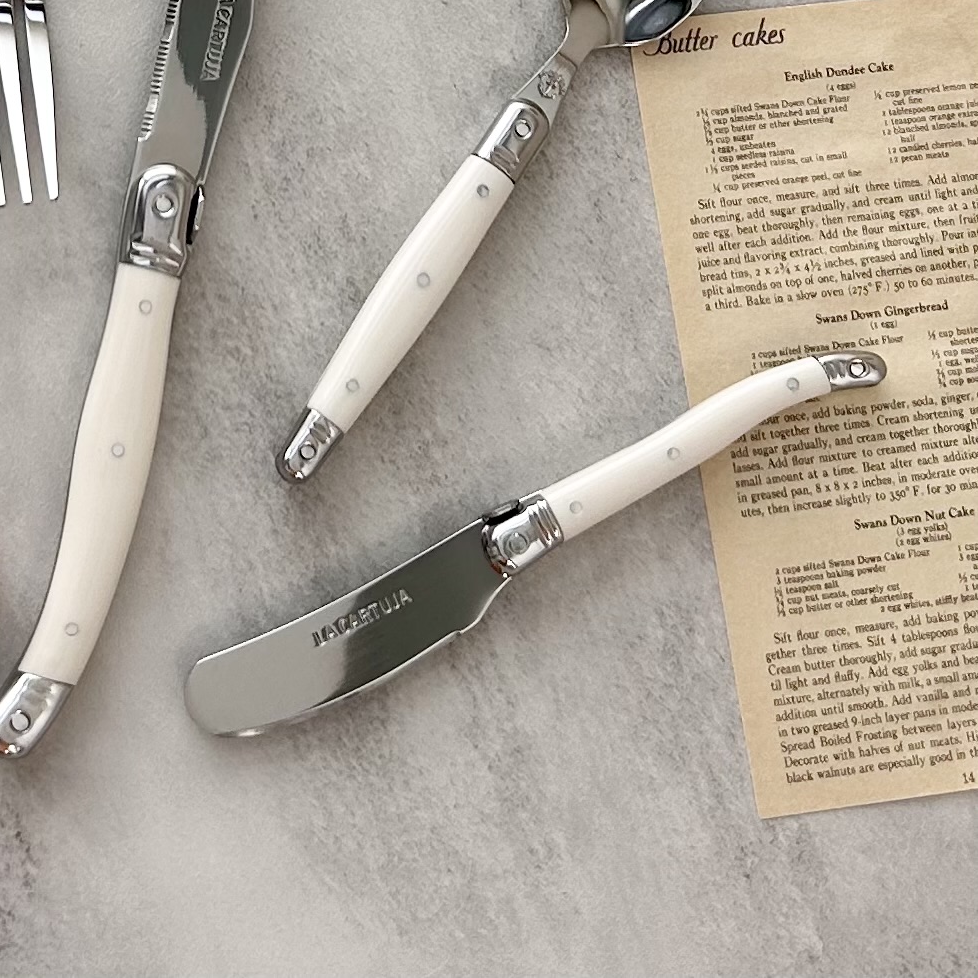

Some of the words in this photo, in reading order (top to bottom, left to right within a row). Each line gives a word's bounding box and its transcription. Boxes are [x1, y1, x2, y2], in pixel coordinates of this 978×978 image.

[643, 26, 718, 56] Butter
[732, 17, 786, 48] cakes
[784, 68, 822, 83] English
[826, 64, 865, 77] Dundee
[867, 60, 893, 73] Cake
[689, 211, 744, 225] shortening,
[746, 207, 765, 219] add
[769, 207, 796, 218] sugar
[800, 199, 849, 216] gradually,
[851, 196, 870, 207] and
[873, 195, 903, 205] cream
[908, 189, 931, 201] until
[934, 186, 958, 200] light
[960, 184, 978, 195] and
[697, 199, 716, 210] Sift
[719, 197, 742, 207] flour
[746, 196, 771, 205] once,
[775, 191, 818, 201] measure,
[822, 185, 840, 196] and
[865, 181, 889, 191] three
[893, 178, 923, 188] times.
[927, 173, 947, 185] Add
[694, 242, 714, 253] well
[718, 240, 740, 251] after
[744, 236, 767, 248] each
[770, 233, 814, 245] addition.
[818, 228, 838, 240] Add
[842, 227, 858, 237] the
[861, 225, 884, 235] flour
[888, 221, 929, 232] mixture,
[933, 217, 955, 227] then
[697, 257, 720, 271] juice
[722, 253, 741, 265] and
[743, 250, 786, 263] flavoring
[829, 239, 879, 253] combining
[941, 230, 964, 240] Pour
[701, 285, 724, 299] split
[726, 280, 767, 294] almonds
[769, 281, 782, 289] on
[784, 279, 802, 289] top
[804, 274, 814, 285] of
[817, 275, 838, 283] one,
[840, 267, 872, 281] halved
[875, 264, 913, 277] cherries
[914, 264, 927, 272] on
[929, 258, 970, 270] another,
[714, 298, 742, 310] third.
[746, 295, 771, 306] Bake
[773, 293, 784, 303] in
[795, 290, 817, 301] slow
[821, 289, 844, 298] oven
[907, 280, 918, 288] to
[815, 313, 847, 324] Swans
[850, 309, 881, 320] Down
[883, 299, 948, 318] Gingerbread
[749, 429, 766, 440] sift
[769, 425, 809, 440] together
[814, 422, 839, 433] three
[843, 419, 873, 429] times.
[876, 415, 910, 425] Cream
[912, 407, 964, 421] shortening
[783, 412, 809, 421] once,
[812, 406, 830, 418] add
[833, 404, 867, 416] baking
[870, 399, 909, 415] powder,
[940, 393, 973, 407] ginger,
[730, 446, 749, 458] add
[752, 445, 778, 457] sugar
[781, 437, 831, 455] gradually,
[834, 434, 853, 446] and
[856, 433, 886, 443] cream
[888, 426, 929, 441] together
[732, 462, 763, 473] lasses.
[767, 456, 788, 469] Add
[791, 455, 814, 466] flour
[818, 451, 857, 462] mixture
[861, 448, 873, 457] to
[876, 441, 916, 456] creamed
[920, 439, 958, 450] mixture
[735, 475, 762, 488] small
[765, 471, 804, 484] amount
[807, 469, 818, 479] at
[862, 461, 886, 472] Beat
[889, 458, 912, 469] after
[917, 453, 939, 466] each
[854, 518, 887, 529] Swans
[890, 513, 921, 525] Down
[925, 509, 945, 521] Nut
[948, 504, 975, 518] Cake
[773, 632, 792, 644] Sift
[796, 630, 819, 641] flour
[824, 628, 850, 637] once,
[854, 622, 898, 634] measure,
[902, 616, 921, 628] add
[926, 613, 959, 625] baking
[767, 664, 801, 675] Cream
[803, 660, 835, 671] butter
[838, 650, 896, 666] thoroughly,
[899, 646, 918, 658] add
[920, 645, 946, 657] sugar
[775, 708, 817, 721] addition
[820, 702, 844, 715] until
[847, 697, 888, 711] smooth.
[891, 693, 912, 705] Add
[915, 689, 949, 702] vanilla
[952, 685, 971, 697] and
[780, 738, 815, 754] Spread
[819, 732, 852, 747] Boiled
[855, 728, 897, 742] Frosting
[901, 723, 942, 735] between
[946, 718, 977, 731] layers
[786, 769, 813, 783] black
[816, 766, 856, 779] walnuts
[858, 764, 874, 773] are
[877, 755, 925, 772] especially
[929, 750, 953, 766] good
[955, 749, 966, 759] in
[963, 772, 975, 784] 14
